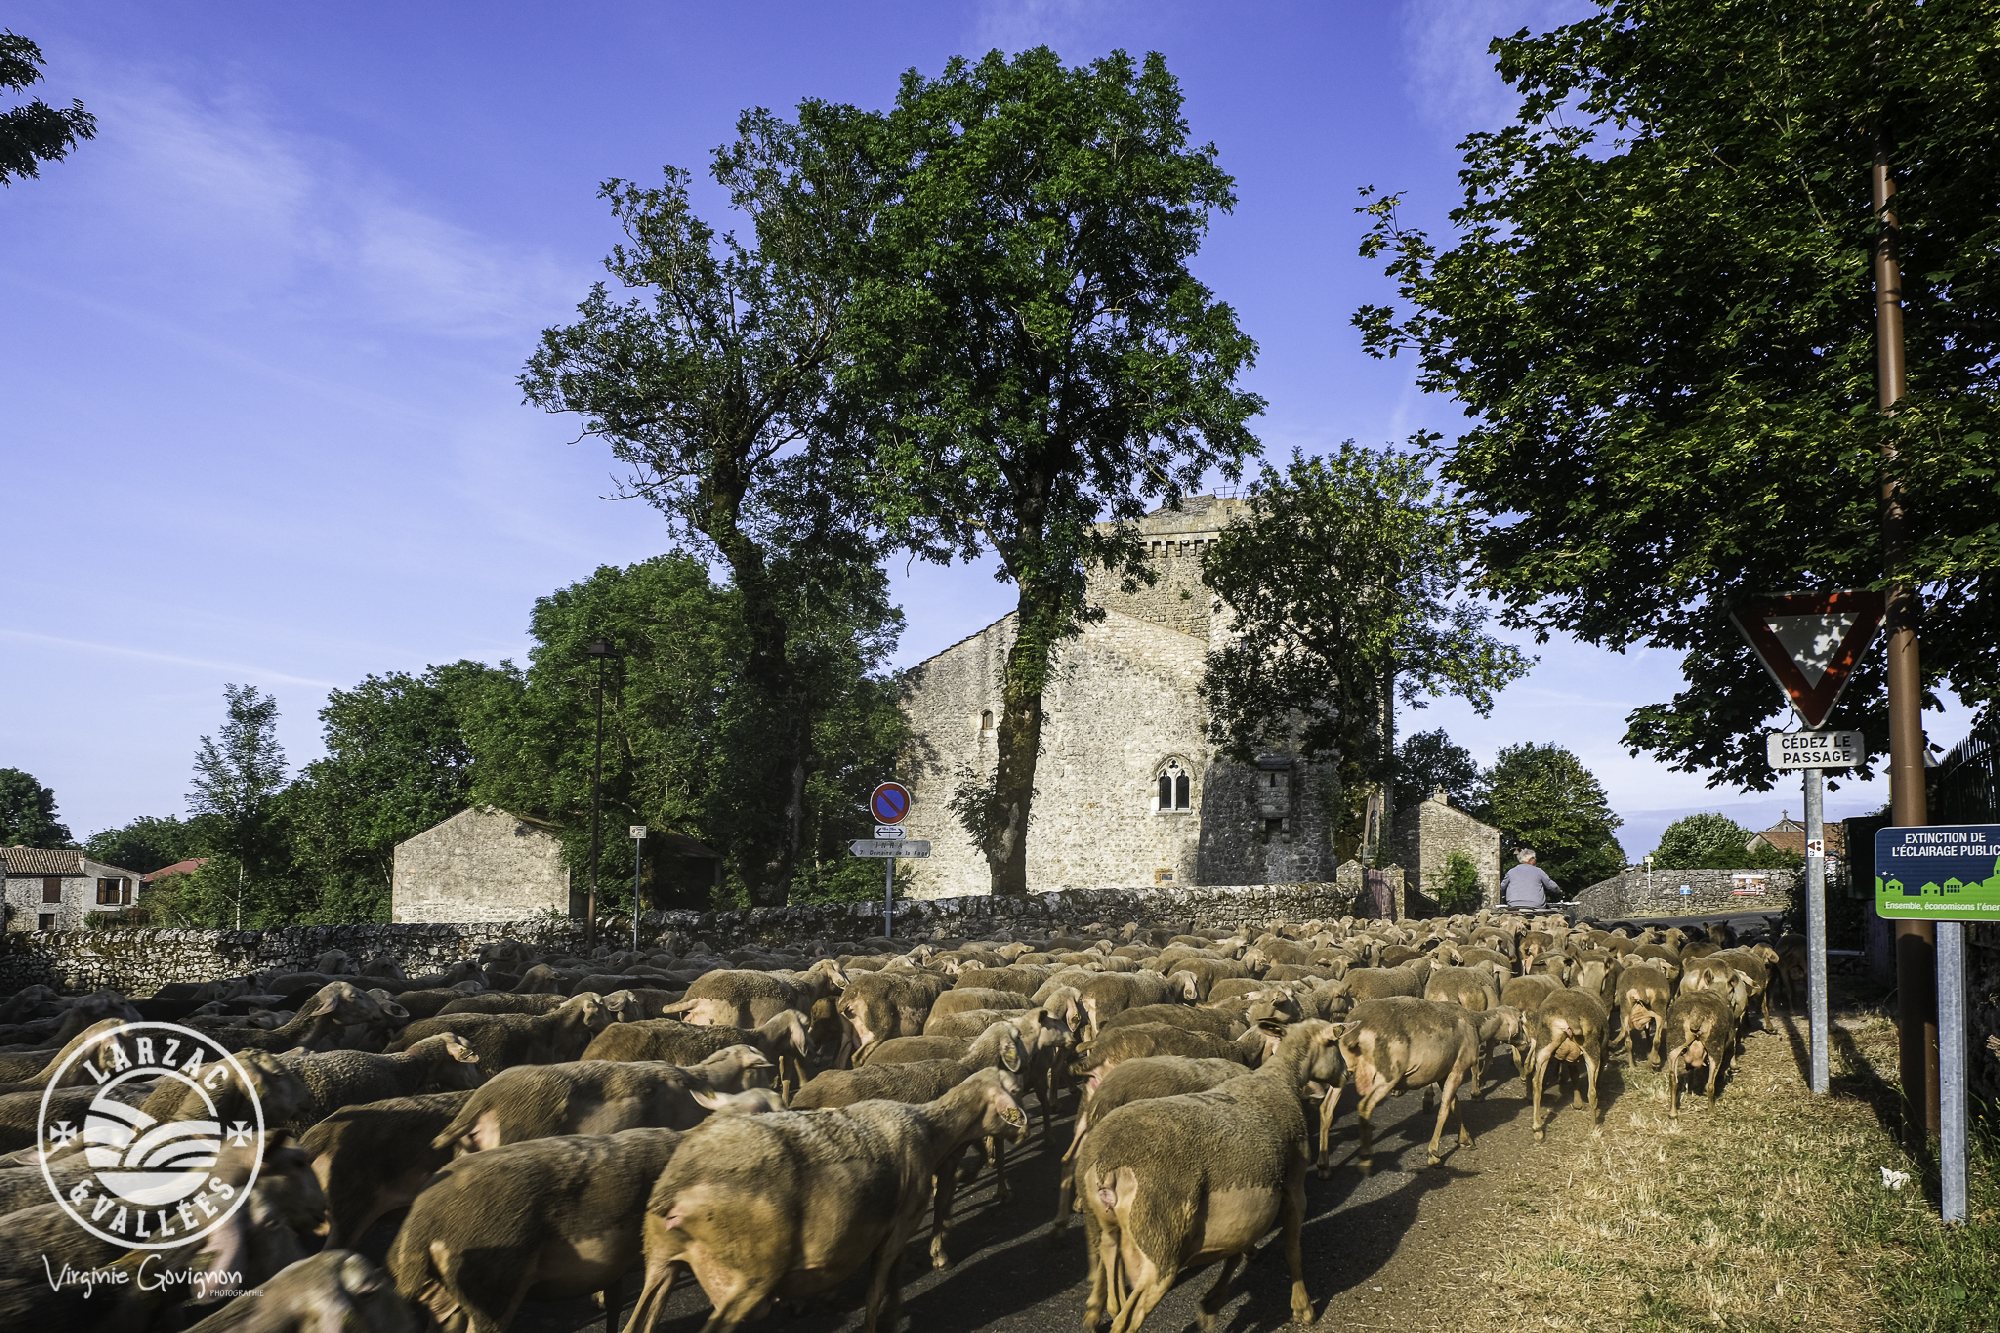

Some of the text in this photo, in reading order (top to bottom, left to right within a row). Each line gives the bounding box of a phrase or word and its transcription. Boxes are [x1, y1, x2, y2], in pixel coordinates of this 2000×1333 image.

[1782, 735, 1851, 749] CÉDEZ LE
[1783, 750, 1851, 764] PASSAGE
[1905, 832, 1987, 844] EXTINCTION DE
[1892, 844, 2000, 857] L'ÉCLAIRAGE PUBLIC
[1885, 901, 1923, 911] Ensemble,
[1924, 901, 1975, 911] économisons
